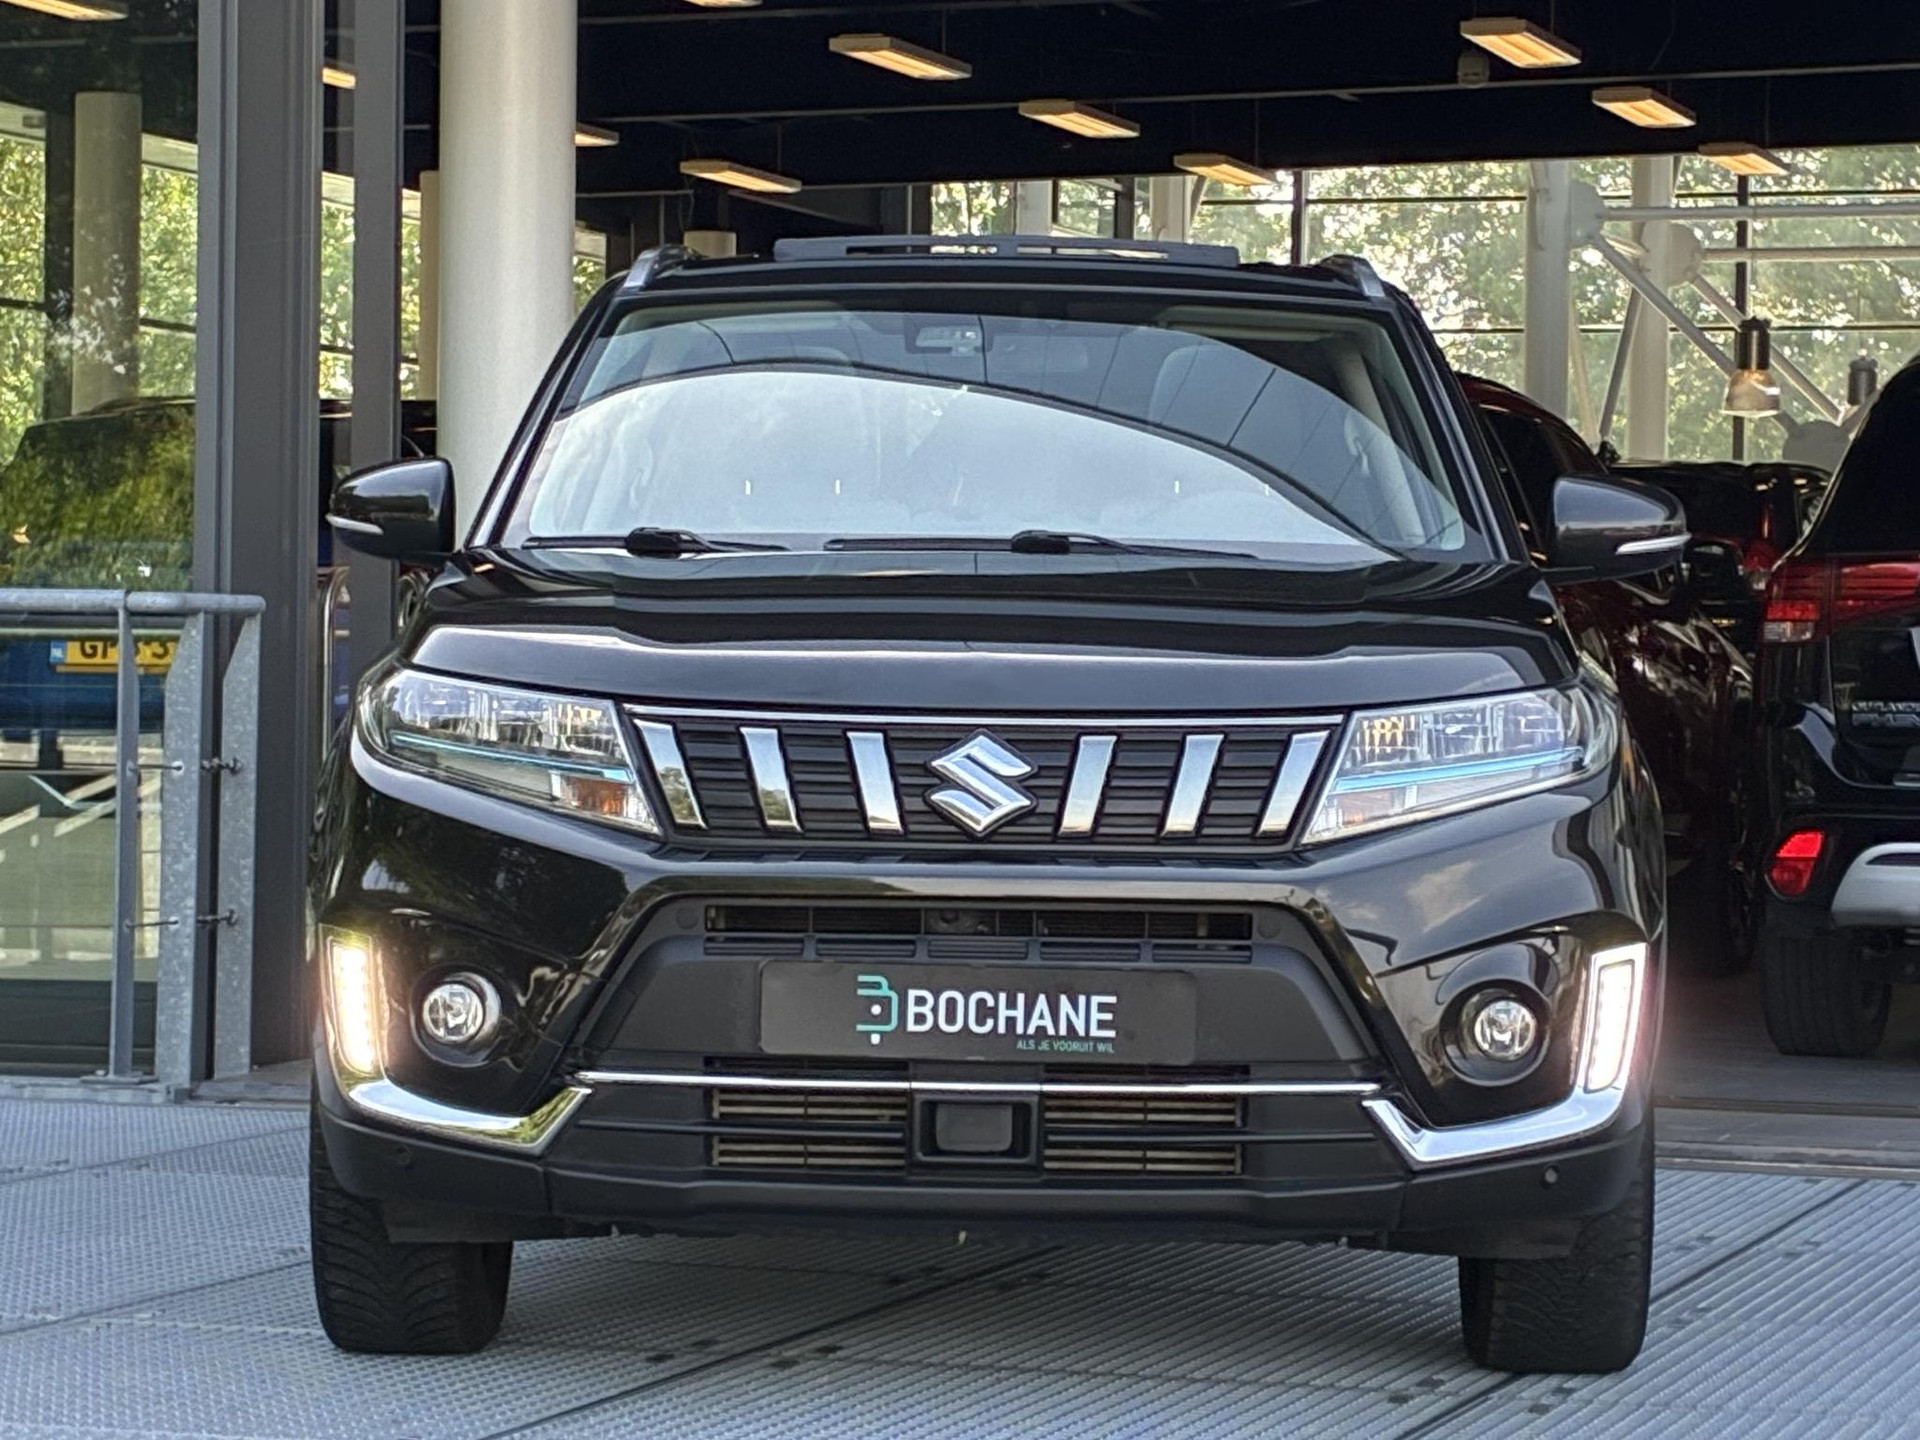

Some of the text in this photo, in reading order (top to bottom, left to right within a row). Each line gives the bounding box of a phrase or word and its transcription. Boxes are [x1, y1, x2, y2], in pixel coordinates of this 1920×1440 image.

[906, 989, 1117, 1038] BOCHANE
[1016, 1039, 1115, 1054] ALS JE VOORUIT WIL
